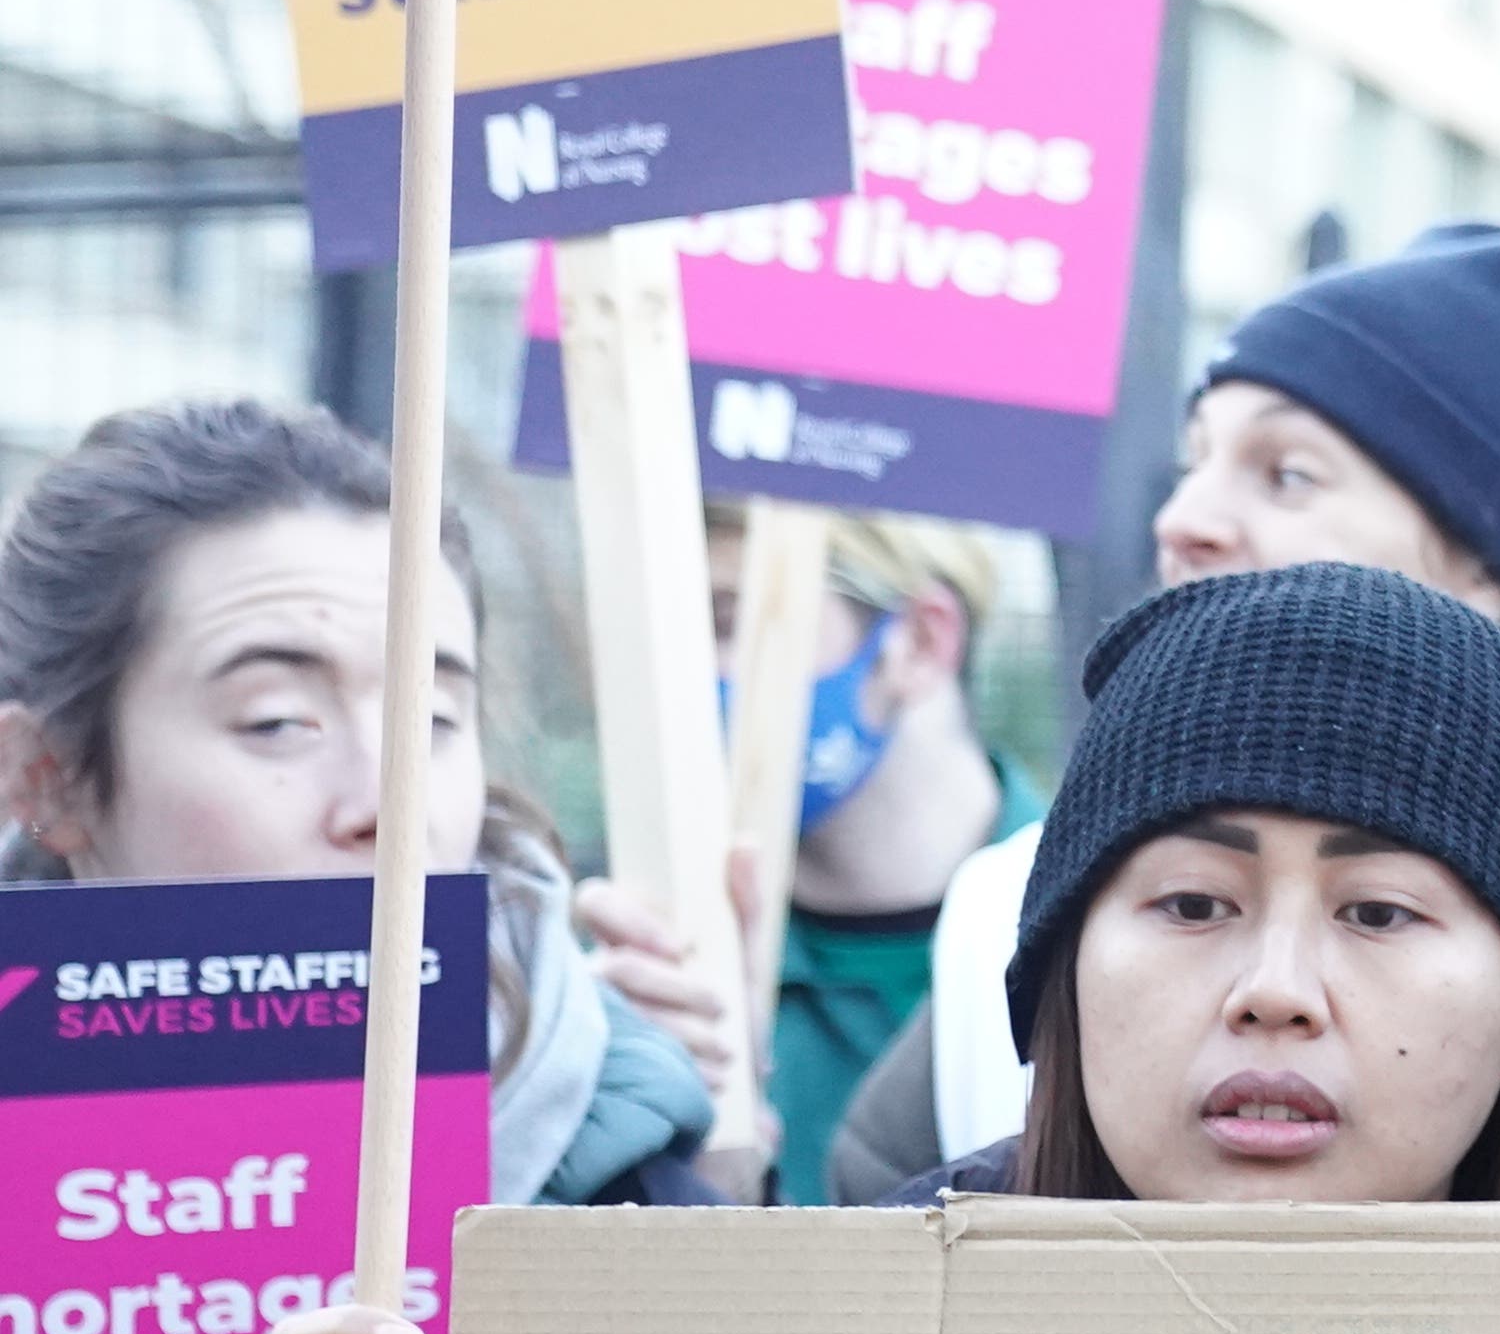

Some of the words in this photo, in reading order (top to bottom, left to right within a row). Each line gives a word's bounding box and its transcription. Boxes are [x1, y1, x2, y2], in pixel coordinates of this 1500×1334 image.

[834, 193, 1064, 307] lives
[55, 959, 189, 1001] SAFE
[56, 996, 214, 1039] SAVES
[230, 992, 364, 1031] LIVES
[54, 1152, 310, 1242] Staff
